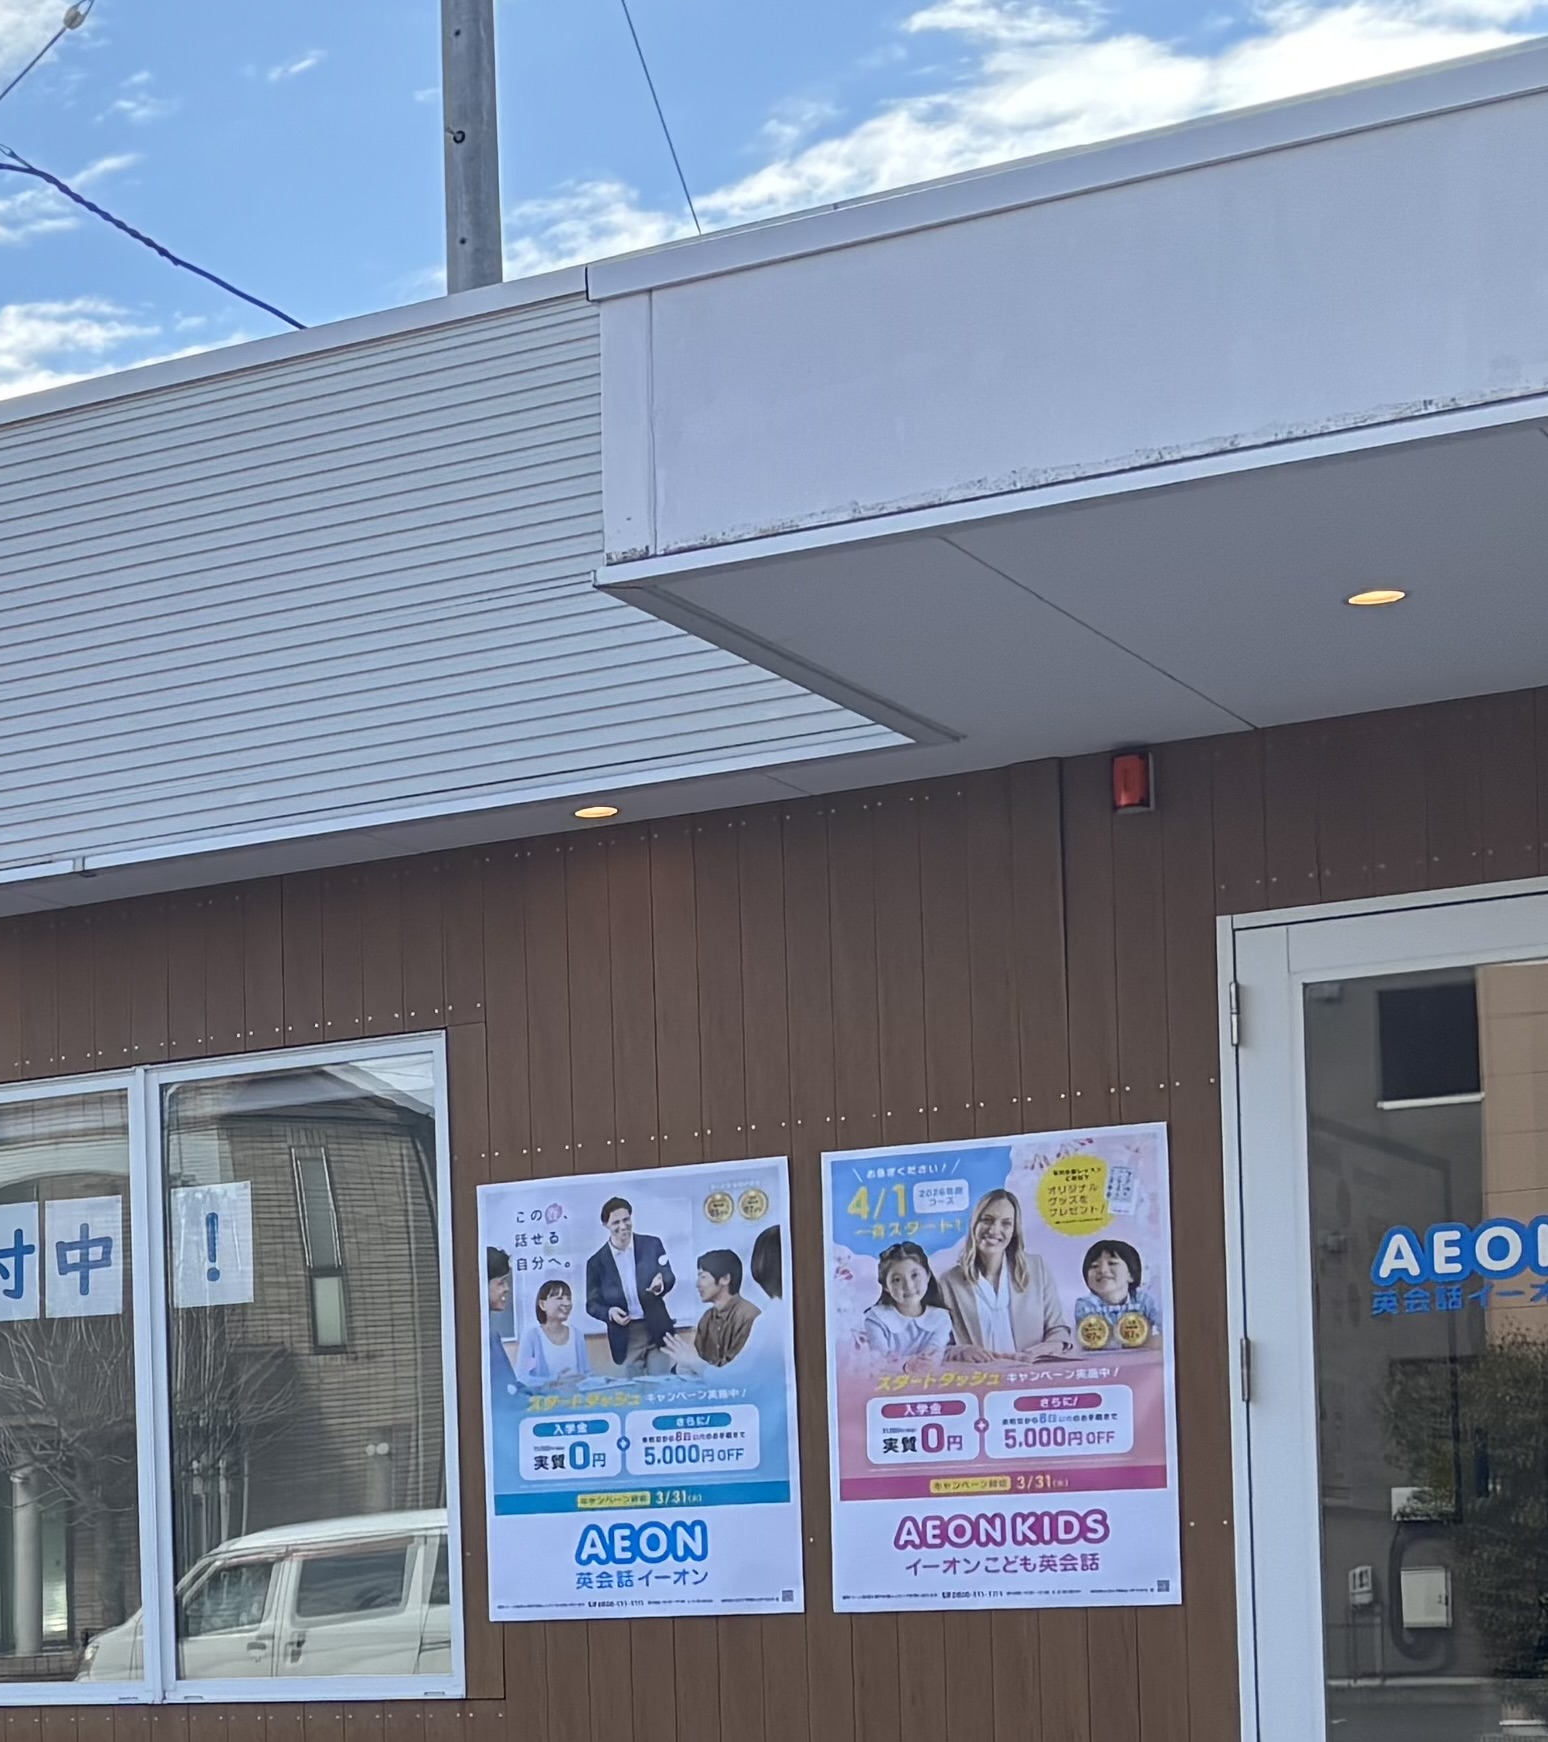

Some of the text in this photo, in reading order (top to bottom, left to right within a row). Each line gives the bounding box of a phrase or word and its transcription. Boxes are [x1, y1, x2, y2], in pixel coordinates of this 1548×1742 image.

[848, 1183, 906, 1220] 4/1
[515, 1231, 559, 1247] 話せる
[516, 1256, 571, 1271] 自分へ。
[894, 1508, 1110, 1550] AEON KIDS
[575, 1519, 708, 1566] AEON
[906, 1553, 1100, 1576] イーオンこども英会話
[575, 1568, 708, 1590] 英会話イーオン
